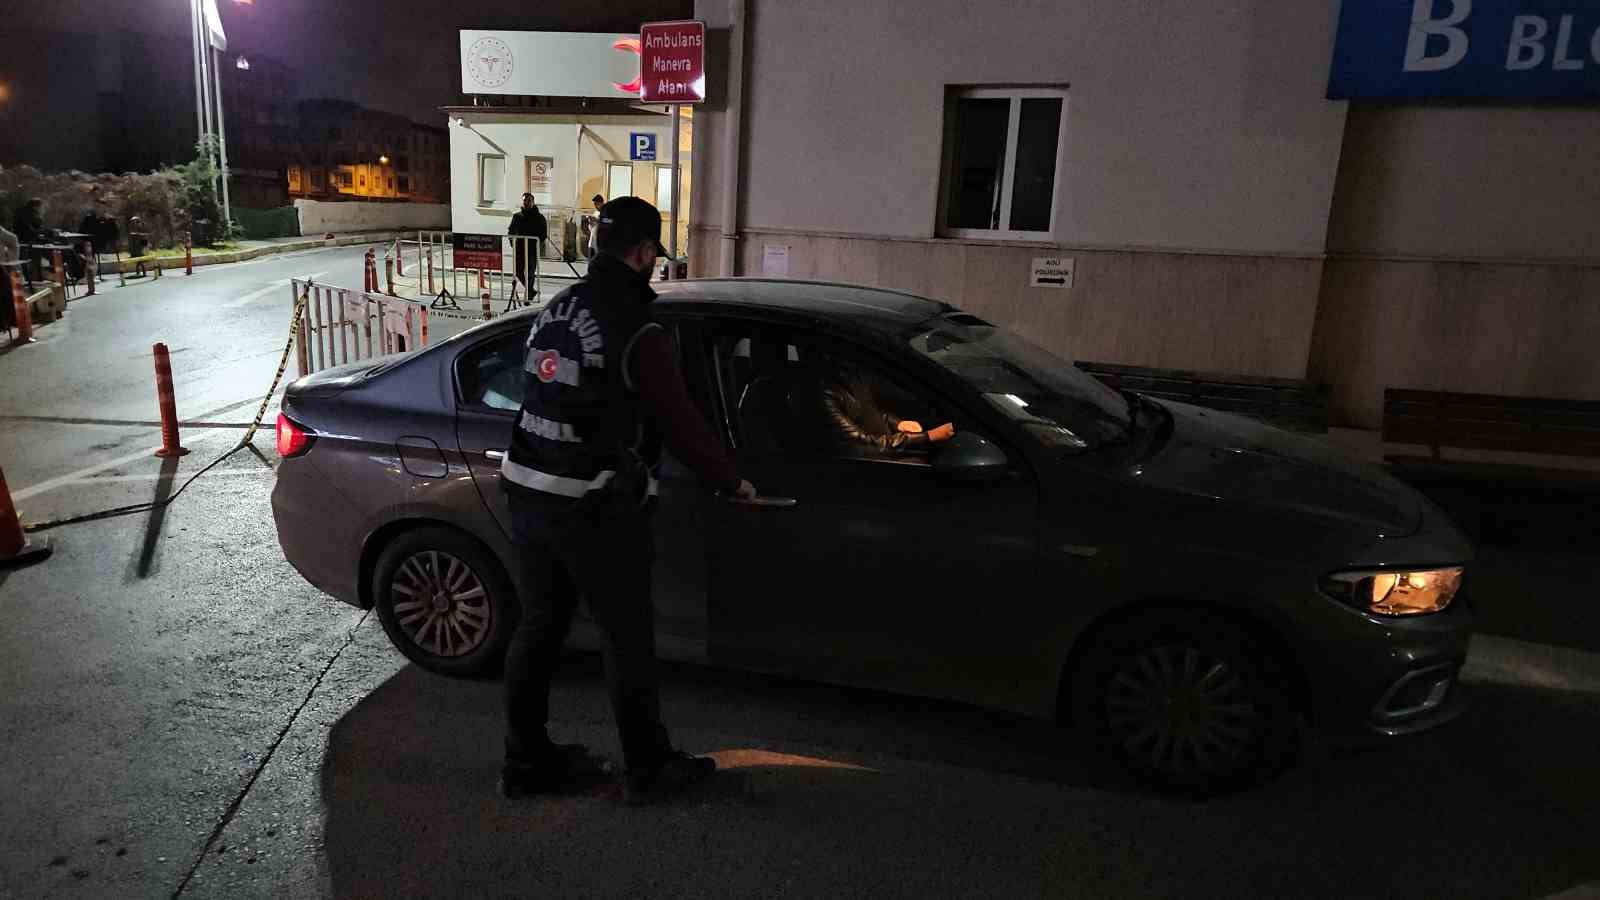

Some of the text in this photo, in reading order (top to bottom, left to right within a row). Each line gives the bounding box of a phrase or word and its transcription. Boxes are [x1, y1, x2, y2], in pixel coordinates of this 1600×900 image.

[645, 32, 702, 49] Ambulans
[1402, 0, 1600, 72] B BL
[653, 56, 692, 73] Manevra
[636, 135, 650, 157] P
[569, 308, 606, 369] ŞUBE
